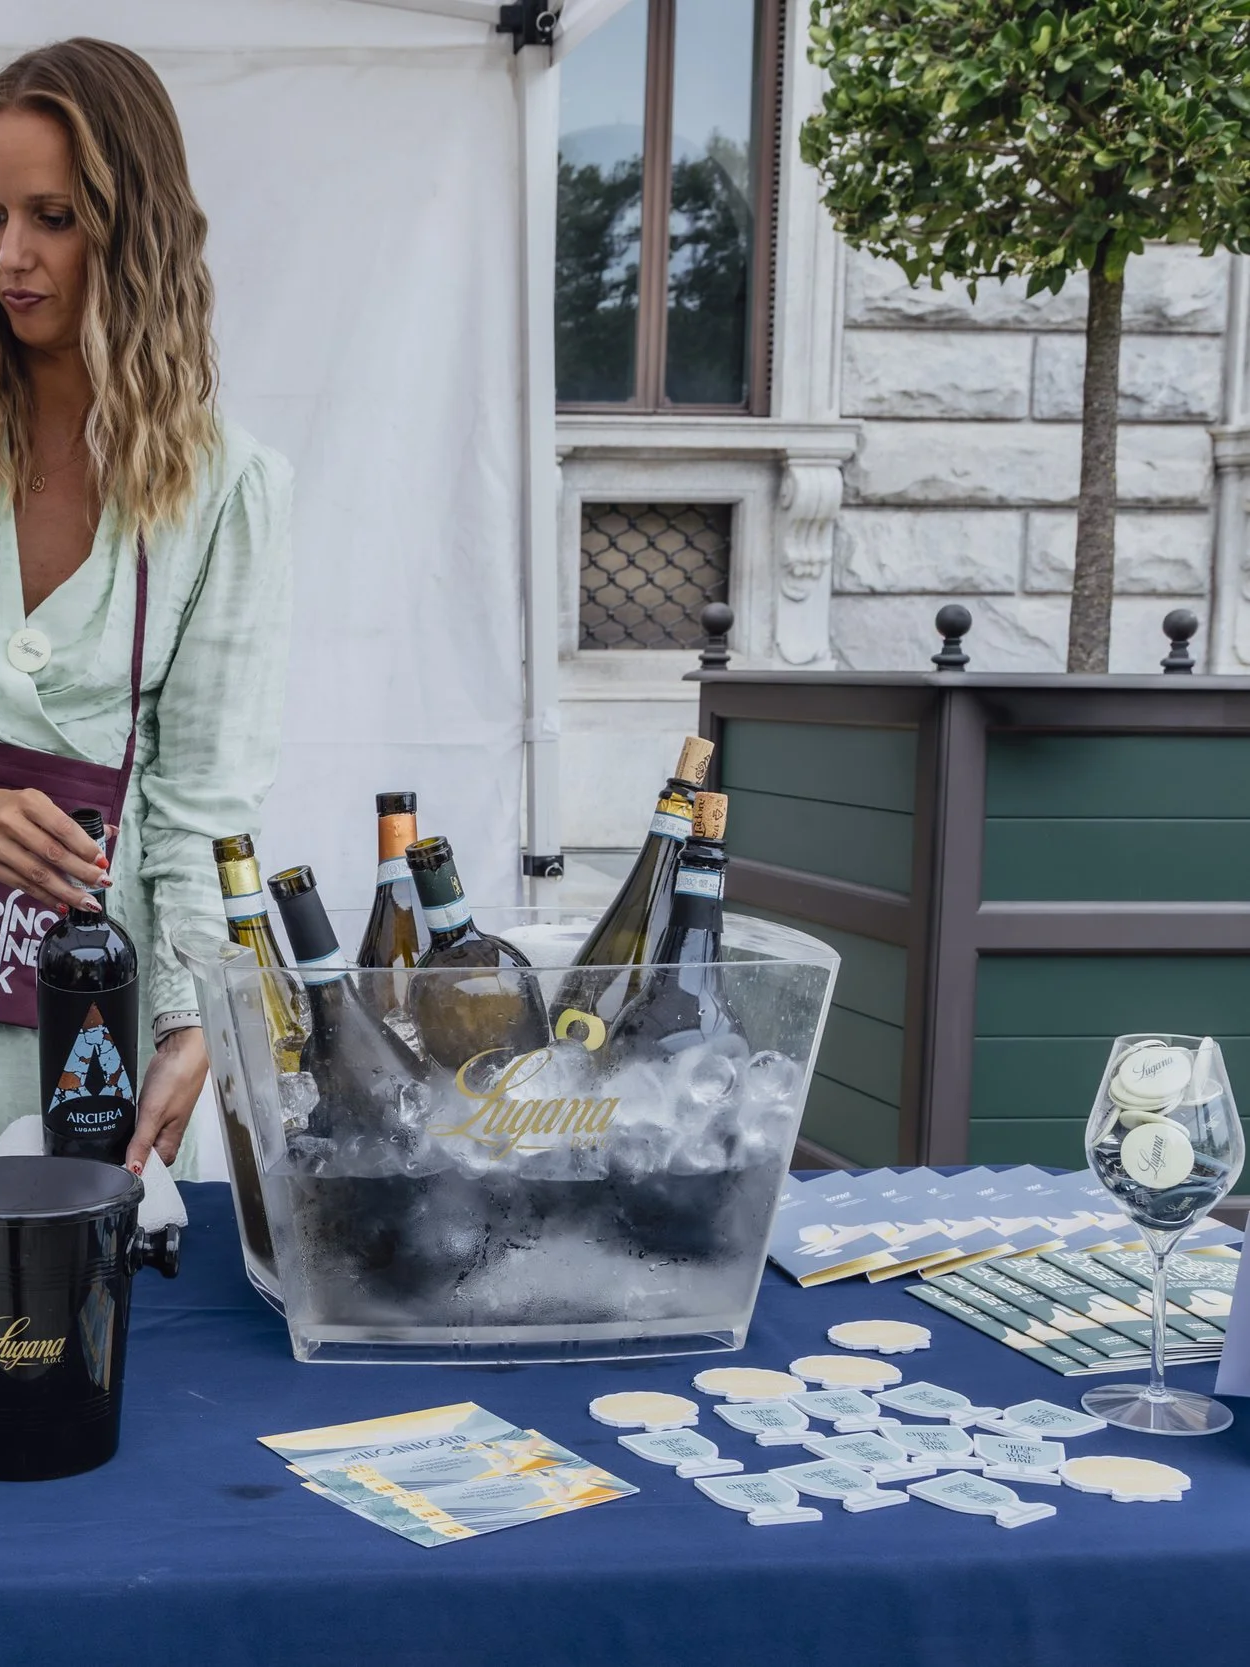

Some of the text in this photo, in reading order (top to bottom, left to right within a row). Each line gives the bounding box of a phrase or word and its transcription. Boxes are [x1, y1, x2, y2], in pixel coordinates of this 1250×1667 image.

[1133, 1056, 1174, 1081] Lugana
[66, 1107, 123, 1124] ARCIERA
[426, 1046, 621, 1162] Lugana
[102, 1123, 116, 1131] DOC
[1137, 1134, 1165, 1180] Lugana
